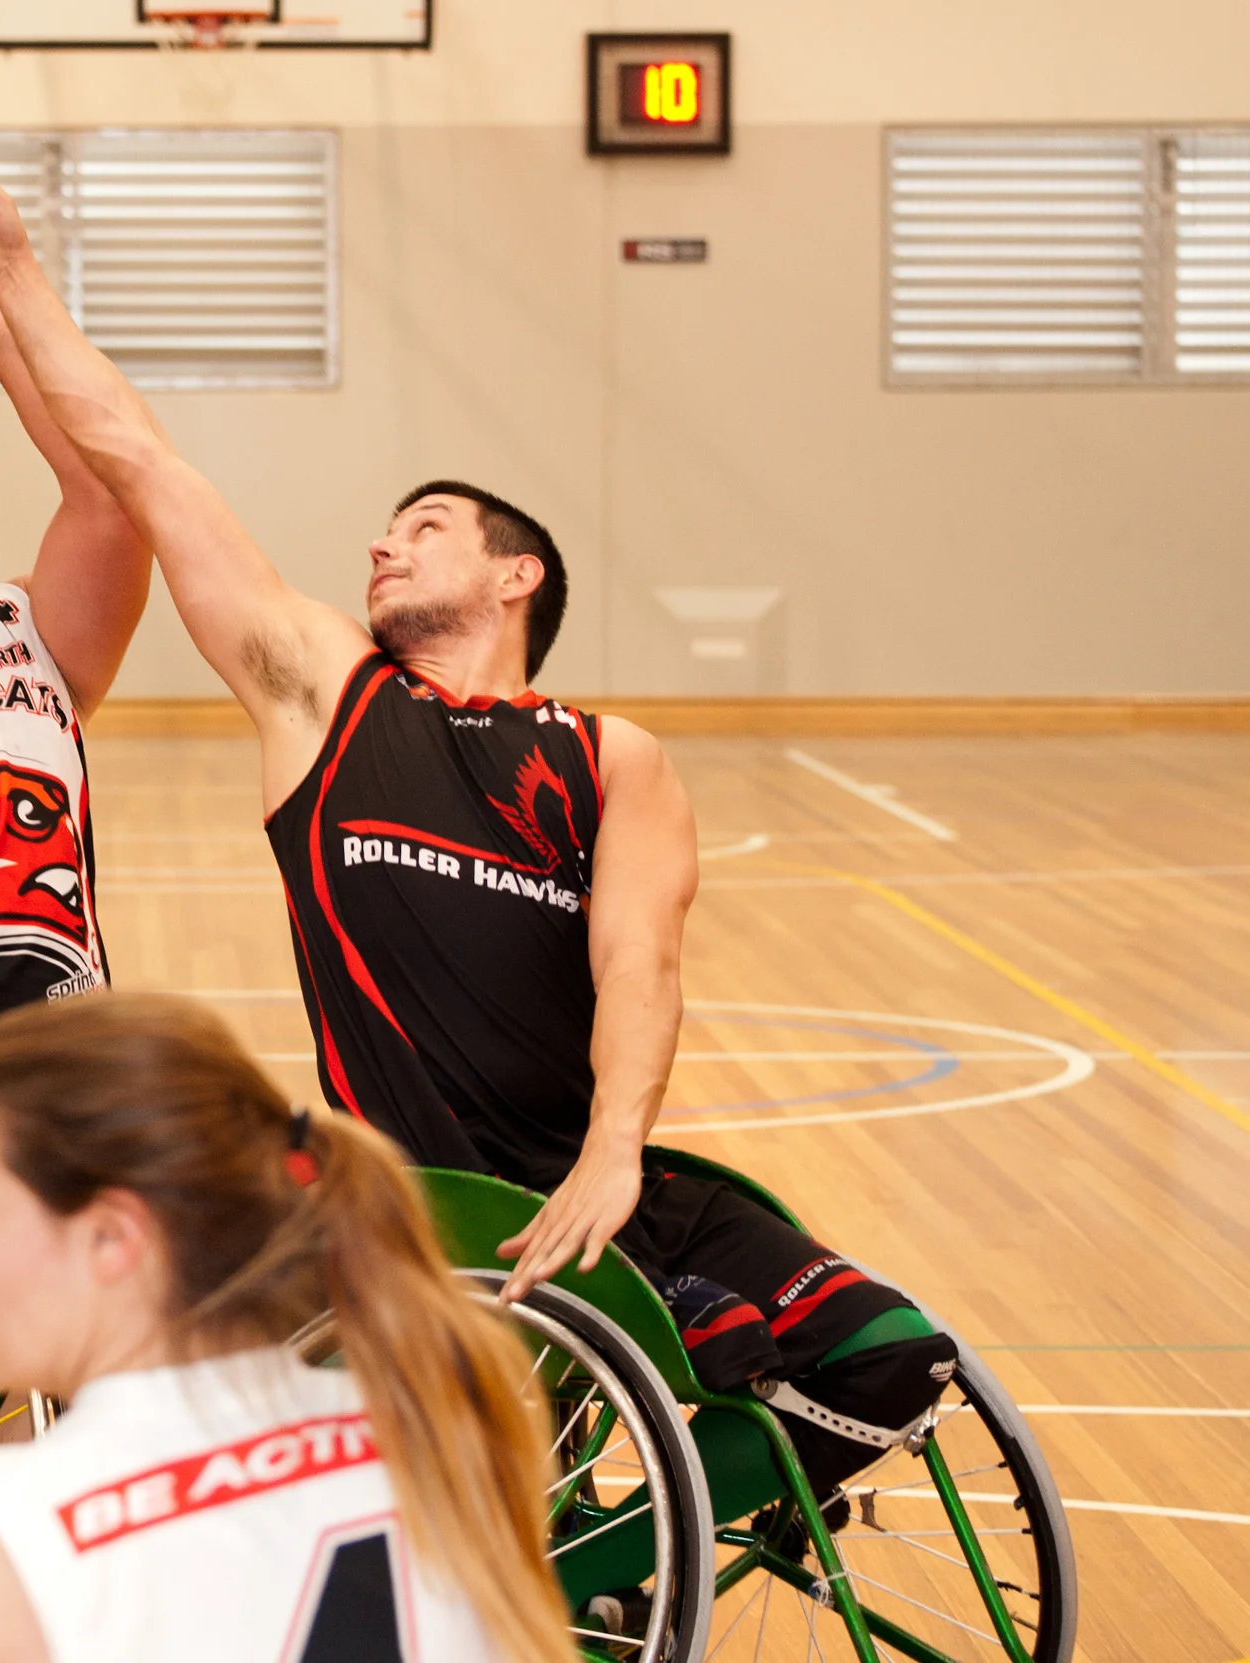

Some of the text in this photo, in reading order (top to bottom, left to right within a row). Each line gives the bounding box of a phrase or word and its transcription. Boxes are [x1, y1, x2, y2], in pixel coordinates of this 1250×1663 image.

[645, 62, 698, 122] 10
[343, 836, 580, 913] ROLLER HAWKS
[778, 1263, 826, 1307] ROLLER
[72, 1472, 178, 1546] BE
